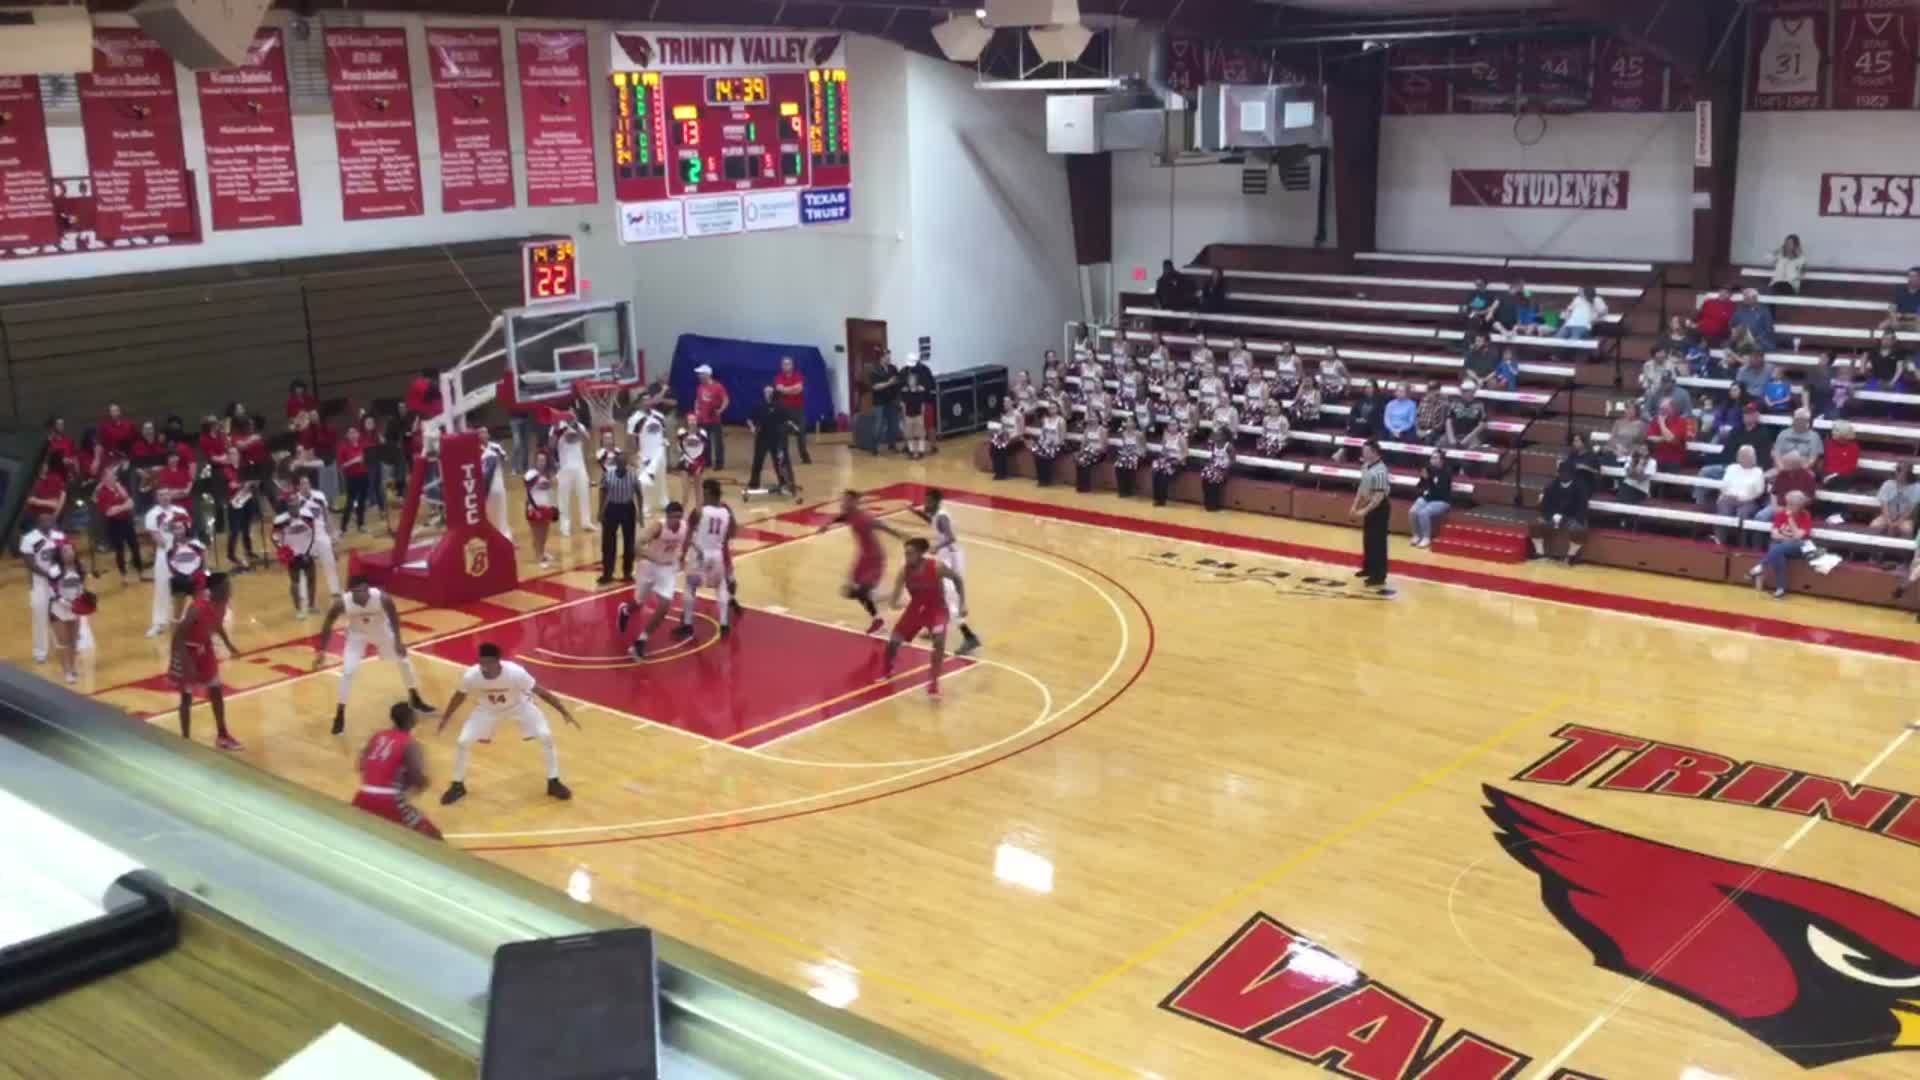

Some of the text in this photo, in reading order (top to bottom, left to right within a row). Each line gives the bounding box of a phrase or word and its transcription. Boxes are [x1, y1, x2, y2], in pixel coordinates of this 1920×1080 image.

[656, 37, 808, 64] TRINITY VALLEY
[1855, 50, 1893, 73] 45
[1775, 53, 1800, 75] 31
[716, 78, 765, 102] 14:39
[682, 120, 699, 145] 13
[791, 116, 802, 138] 9
[688, 156, 701, 184] 2
[804, 192, 847, 206] TEXAS
[1501, 172, 1620, 207] STUDENTS
[804, 206, 847, 220] TRUST
[538, 265, 568, 297] 22
[461, 463, 481, 526] TVCC
[708, 517, 722, 535] 11
